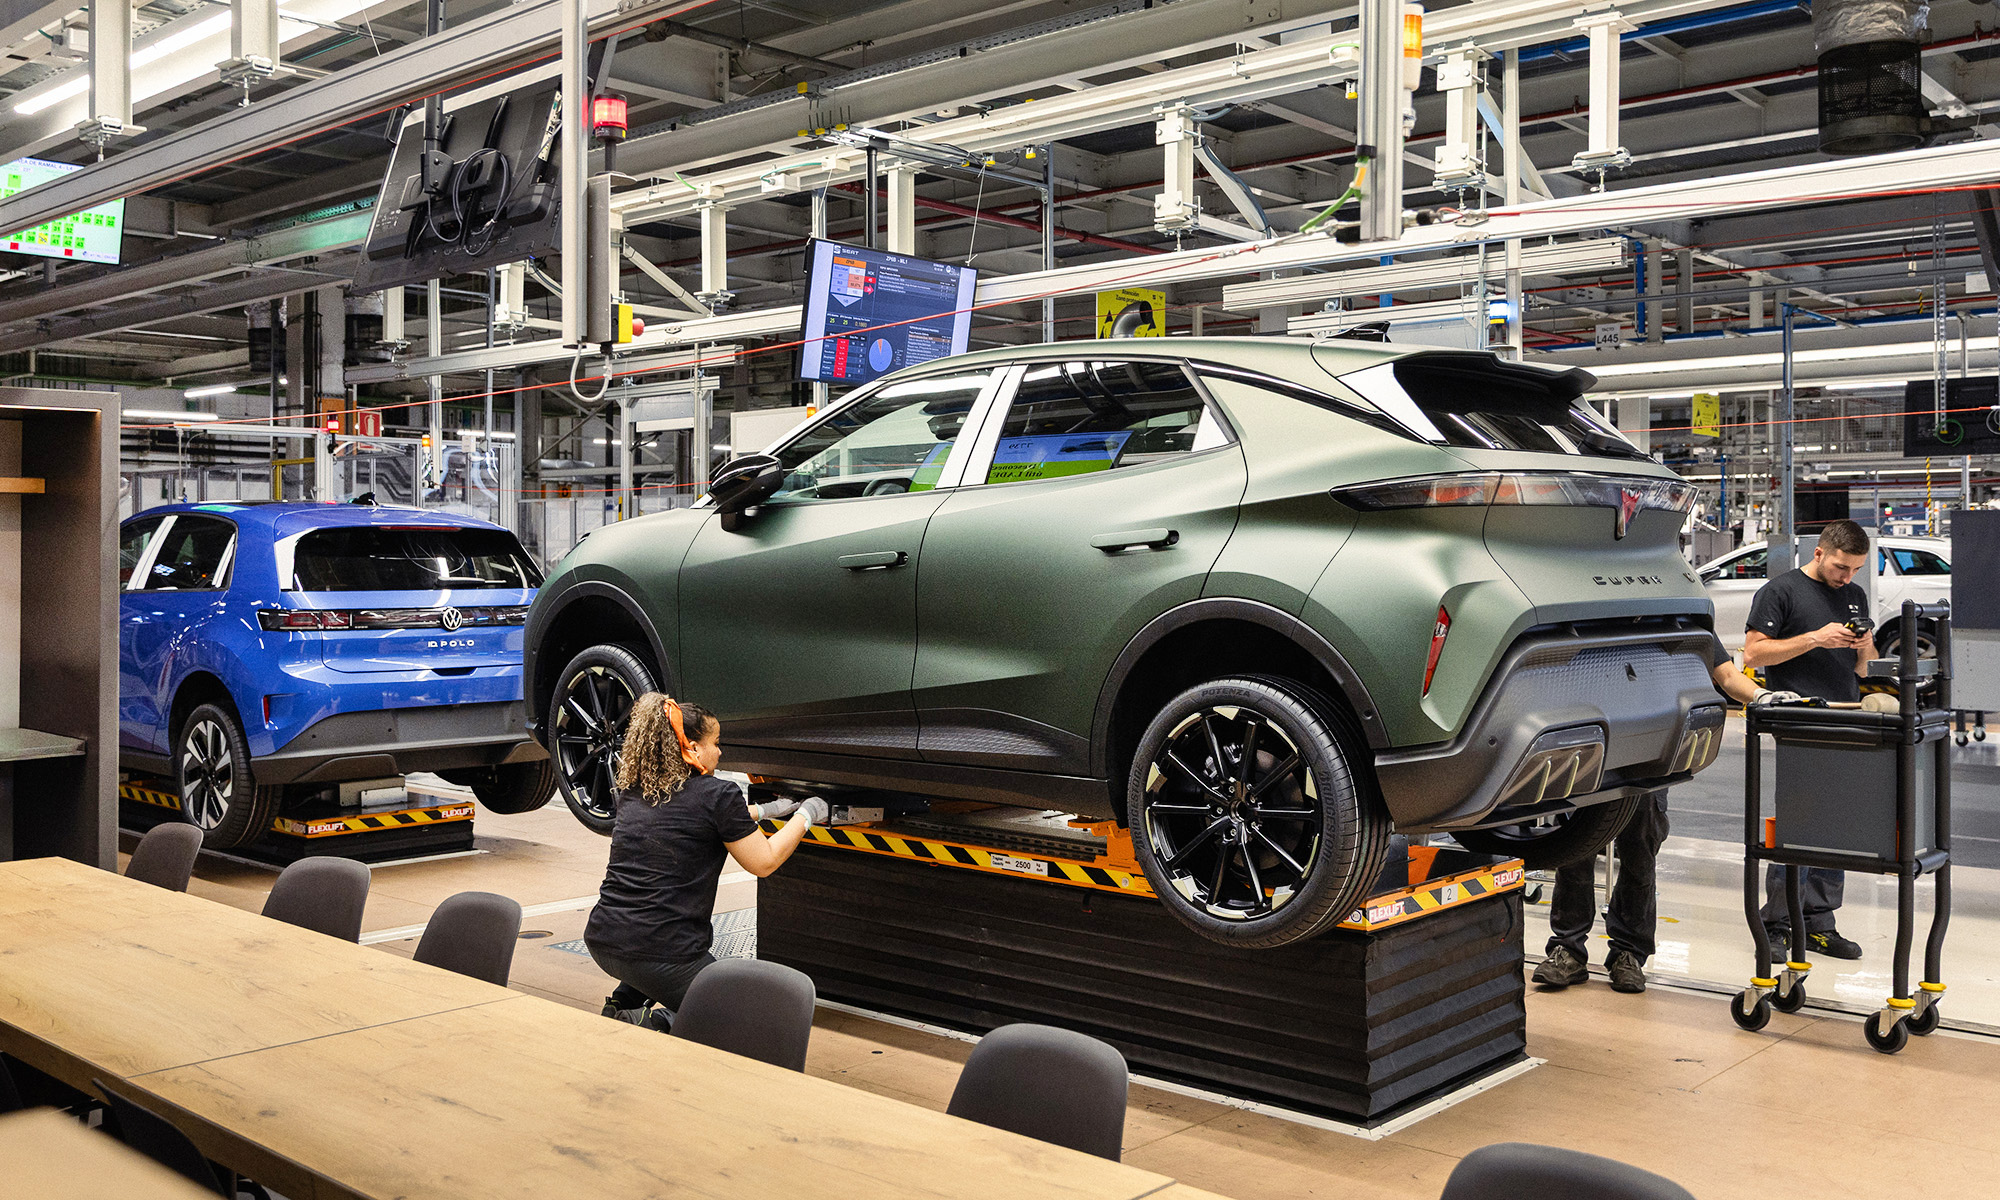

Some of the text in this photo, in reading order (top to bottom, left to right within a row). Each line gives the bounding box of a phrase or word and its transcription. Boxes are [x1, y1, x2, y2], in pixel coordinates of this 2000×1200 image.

[38, 161, 57, 169] RAMAL
[1596, 333, 1619, 344] L445
[1592, 575, 1663, 586] CUPRA
[440, 639, 475, 647] POLO
[1201, 687, 1251, 697] POTENZA
[1130, 762, 1146, 851] BRIDGESTONE
[441, 807, 475, 819] FLEXLIFT
[1318, 771, 1336, 865] BRIDGESTONE
[308, 822, 345, 834] FLEXLIFT
[1015, 860, 1031, 870] 2500
[1493, 869, 1523, 887] FLEXLIFT
[1446, 887, 1452, 901] 2
[1369, 901, 1405, 923] FLEXLIFT
